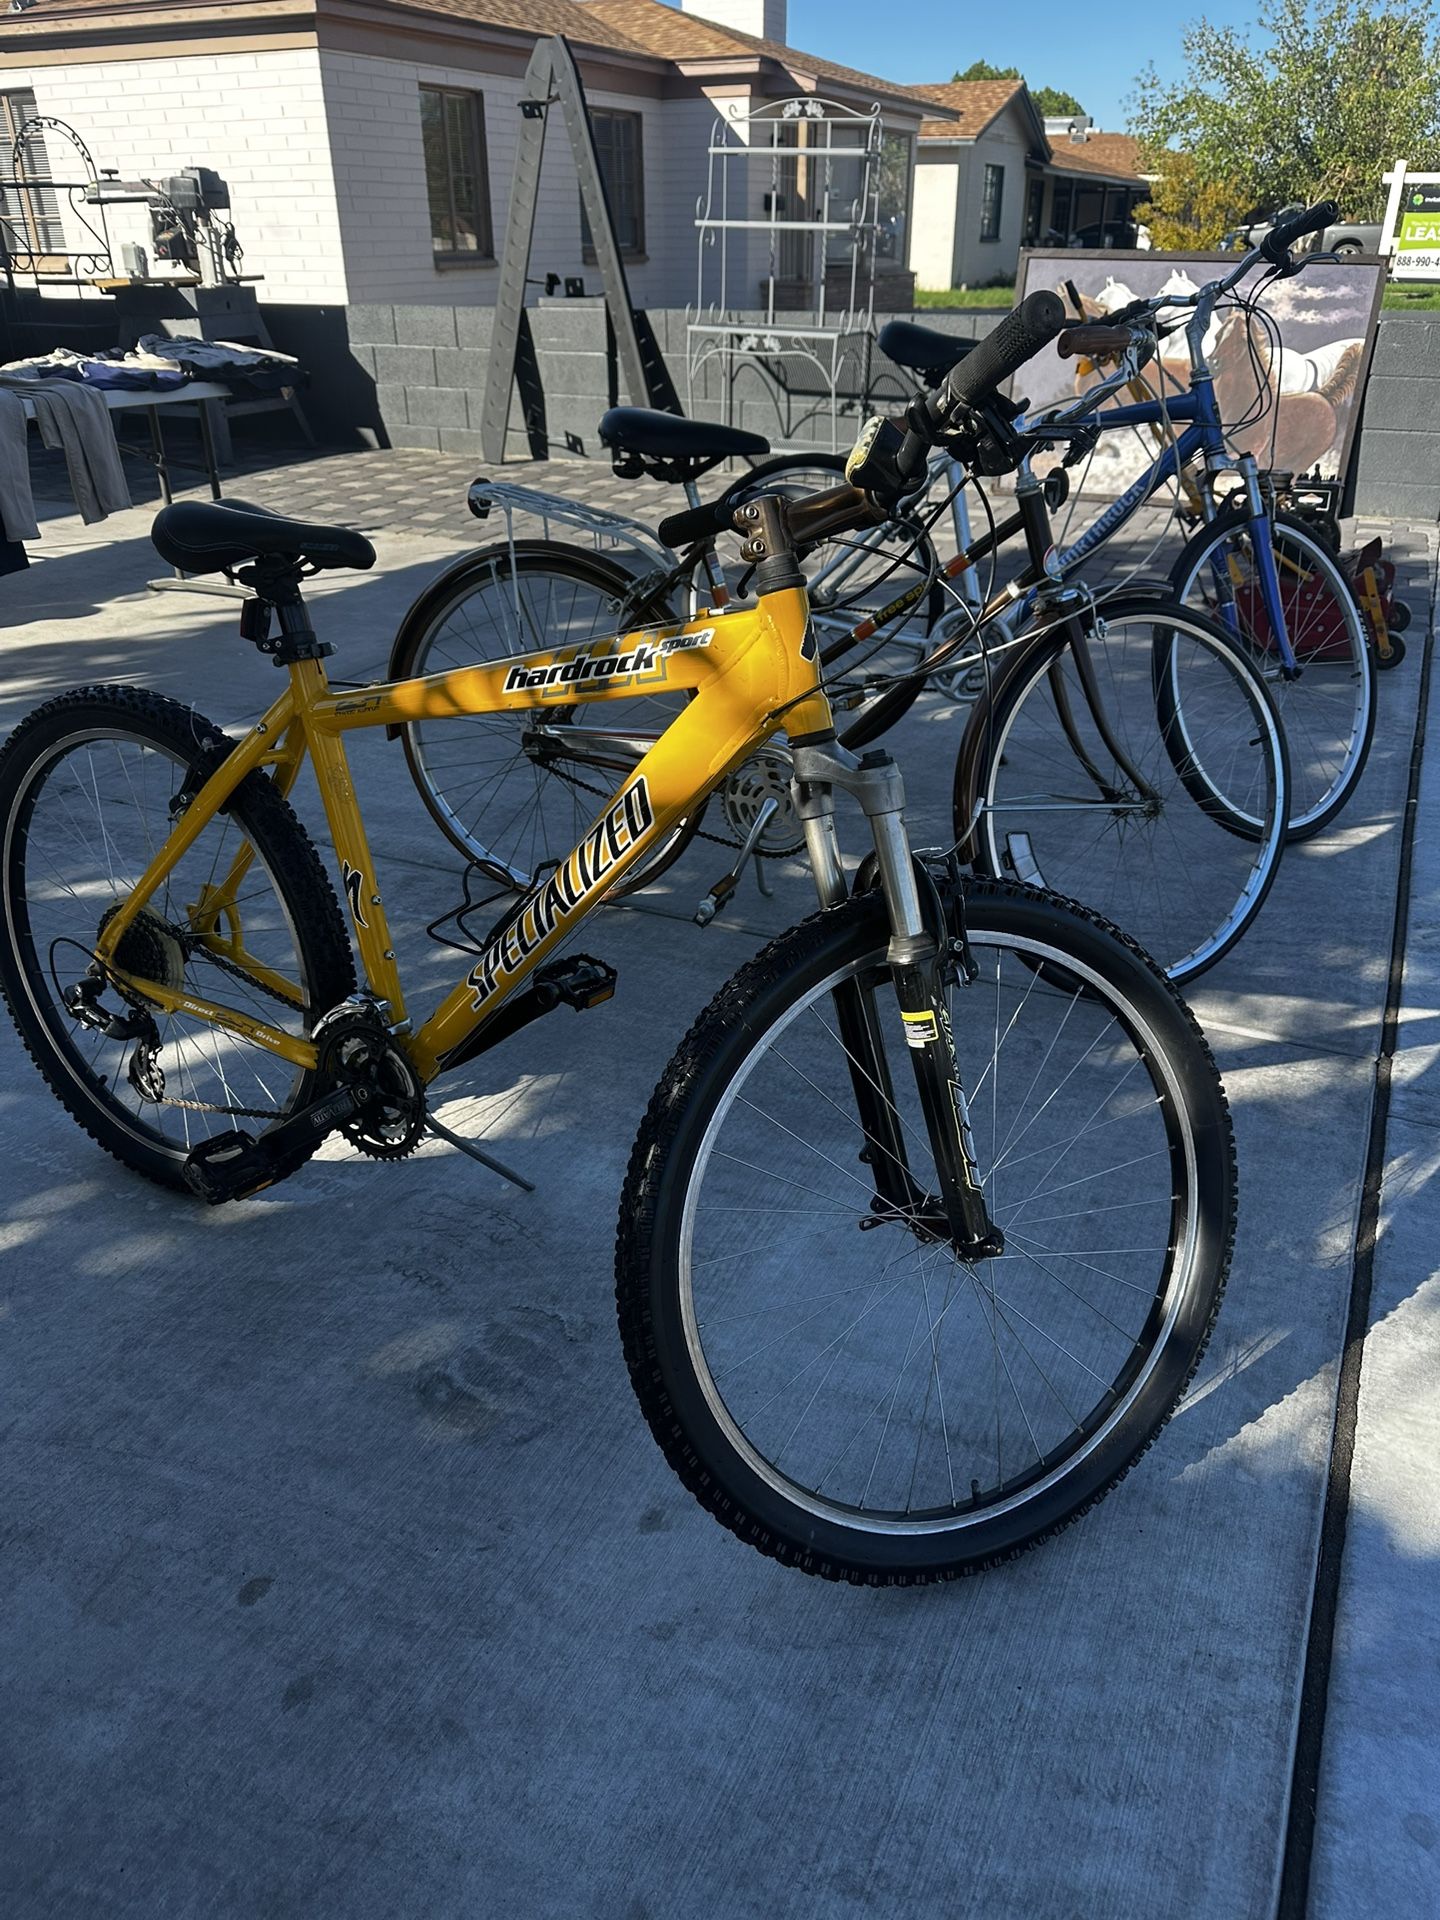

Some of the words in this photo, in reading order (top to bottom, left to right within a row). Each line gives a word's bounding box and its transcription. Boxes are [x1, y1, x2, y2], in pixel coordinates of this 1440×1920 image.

[503, 643, 660, 693] hardrock
[660, 630, 712, 654] sport
[467, 774, 655, 1012] SPECIALIZED
